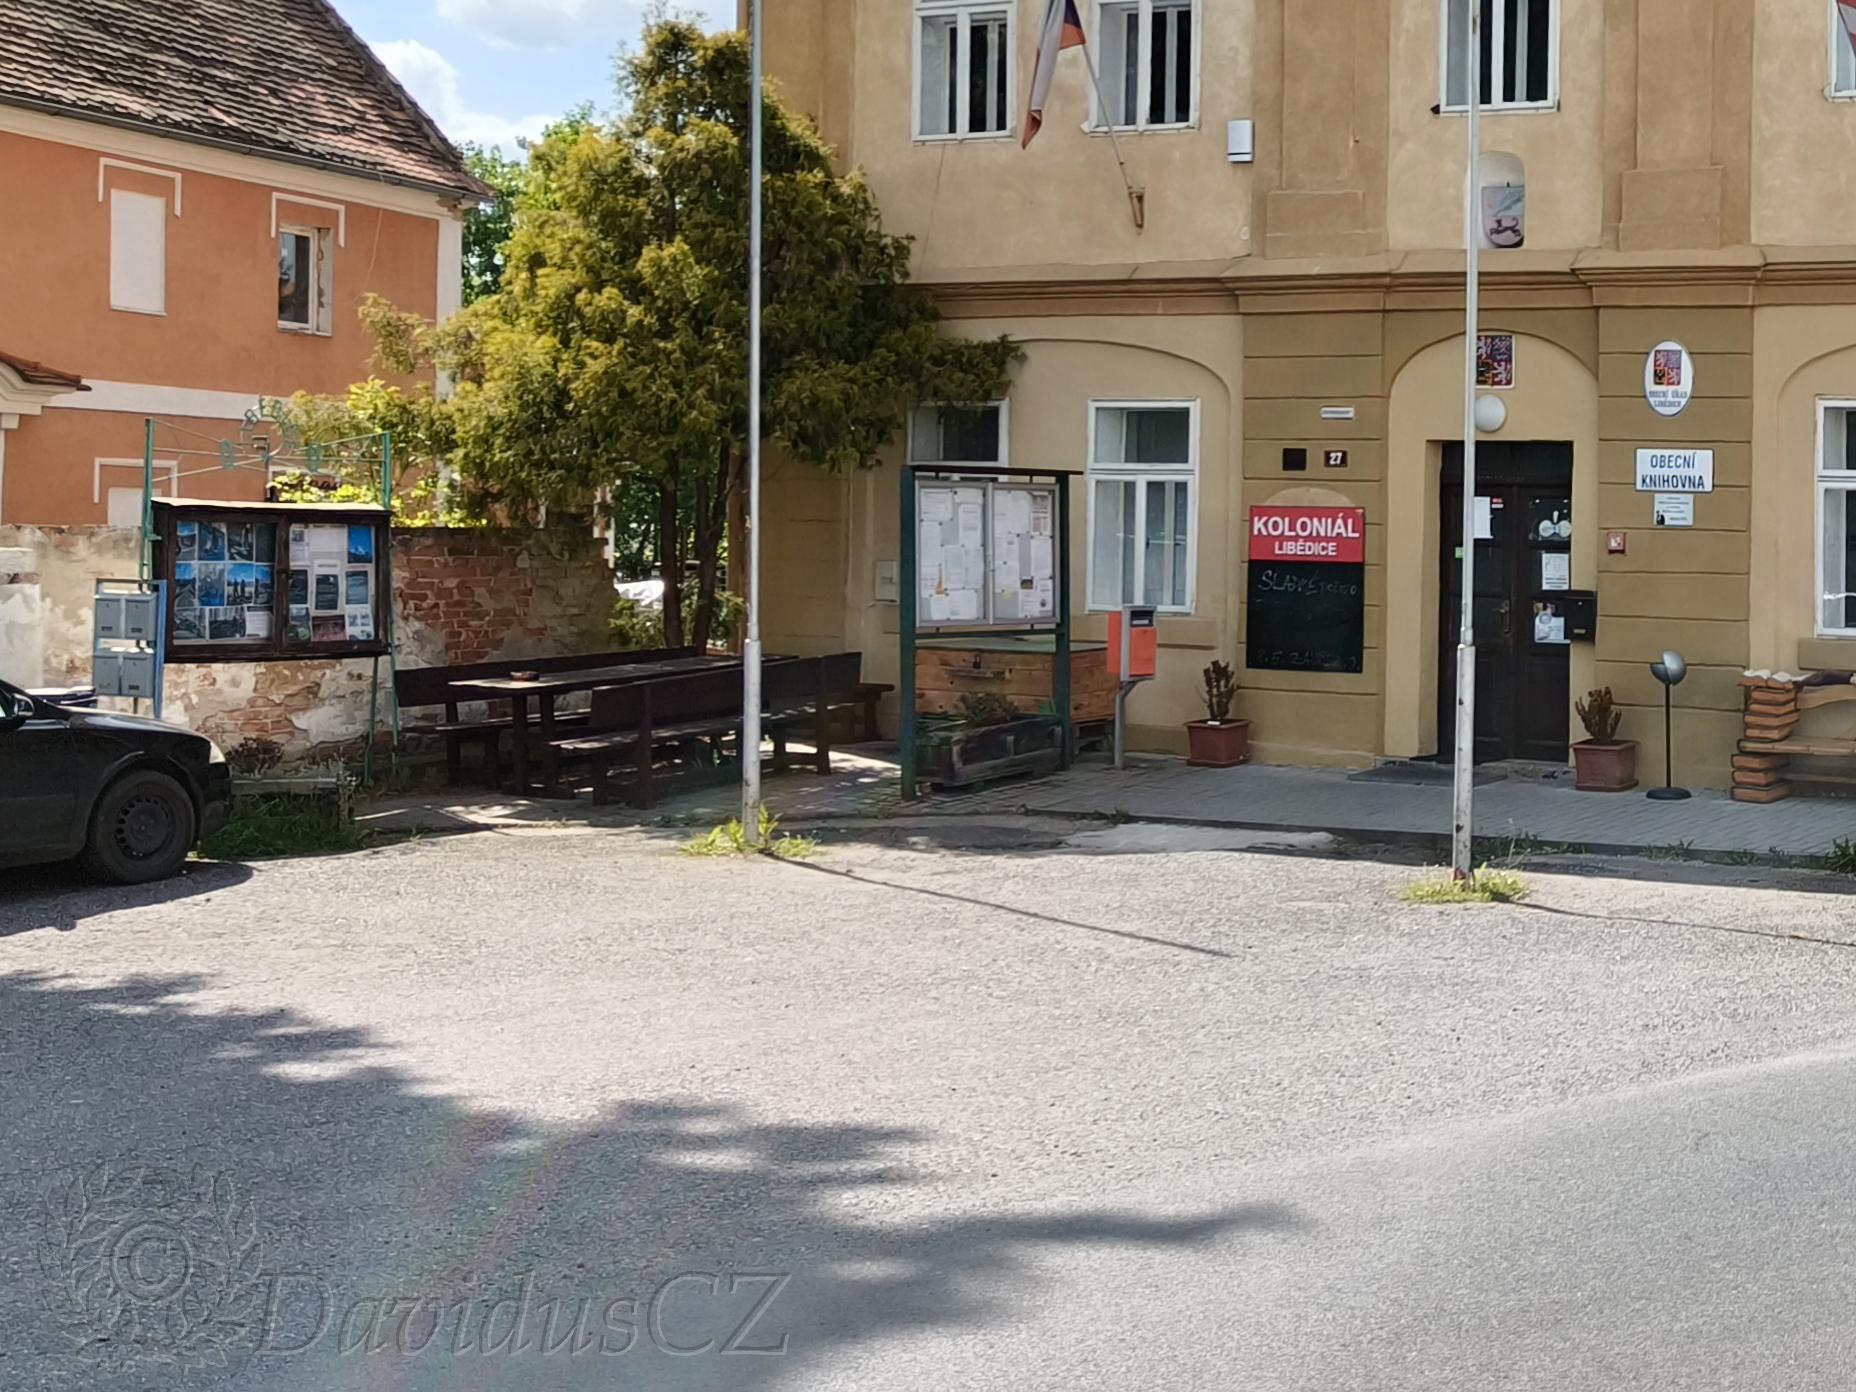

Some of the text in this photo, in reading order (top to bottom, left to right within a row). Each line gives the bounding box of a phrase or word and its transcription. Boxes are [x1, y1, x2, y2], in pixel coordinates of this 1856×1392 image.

[1329, 452, 1343, 465] 27
[1650, 452, 1697, 469] OBECNÍ
[1641, 474, 1705, 490] KNIHOVNA
[1253, 513, 1360, 538] KOLONIÁL
[1274, 539, 1338, 556] LIBĚDICE
